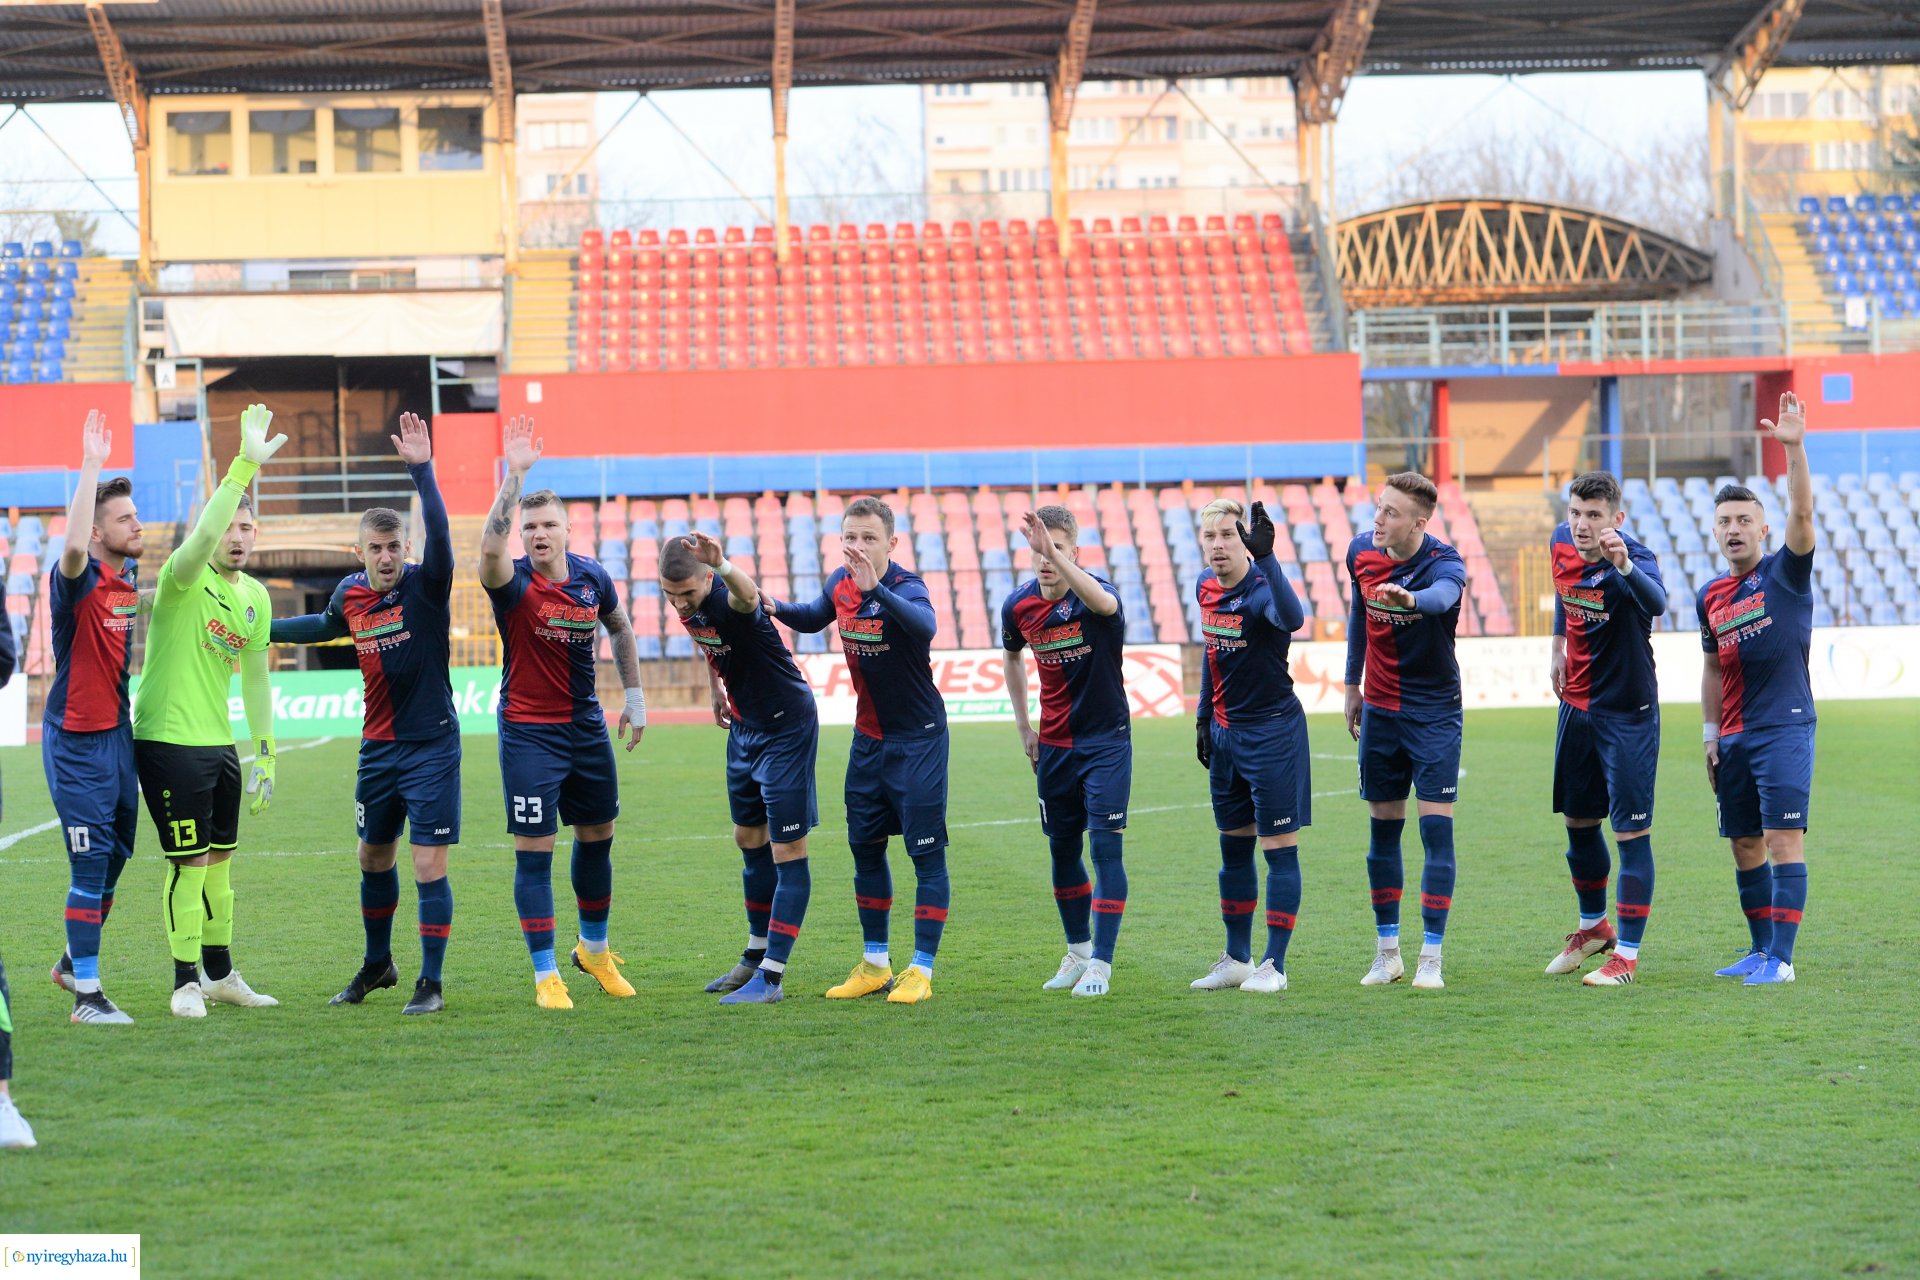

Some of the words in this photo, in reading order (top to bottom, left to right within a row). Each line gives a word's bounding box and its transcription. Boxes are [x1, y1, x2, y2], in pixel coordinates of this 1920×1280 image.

[513, 795, 543, 824] 23
[1108, 812, 1124, 821] JAKO
[1631, 812, 1647, 821] JAKO
[1783, 812, 1801, 820] JAKO
[1273, 817, 1291, 827] JAKO
[433, 827, 450, 835] JAKO
[782, 823, 800, 833] JAKO
[170, 819, 198, 848] 13
[67, 825, 90, 853] 10
[917, 836, 935, 846] JAKO
